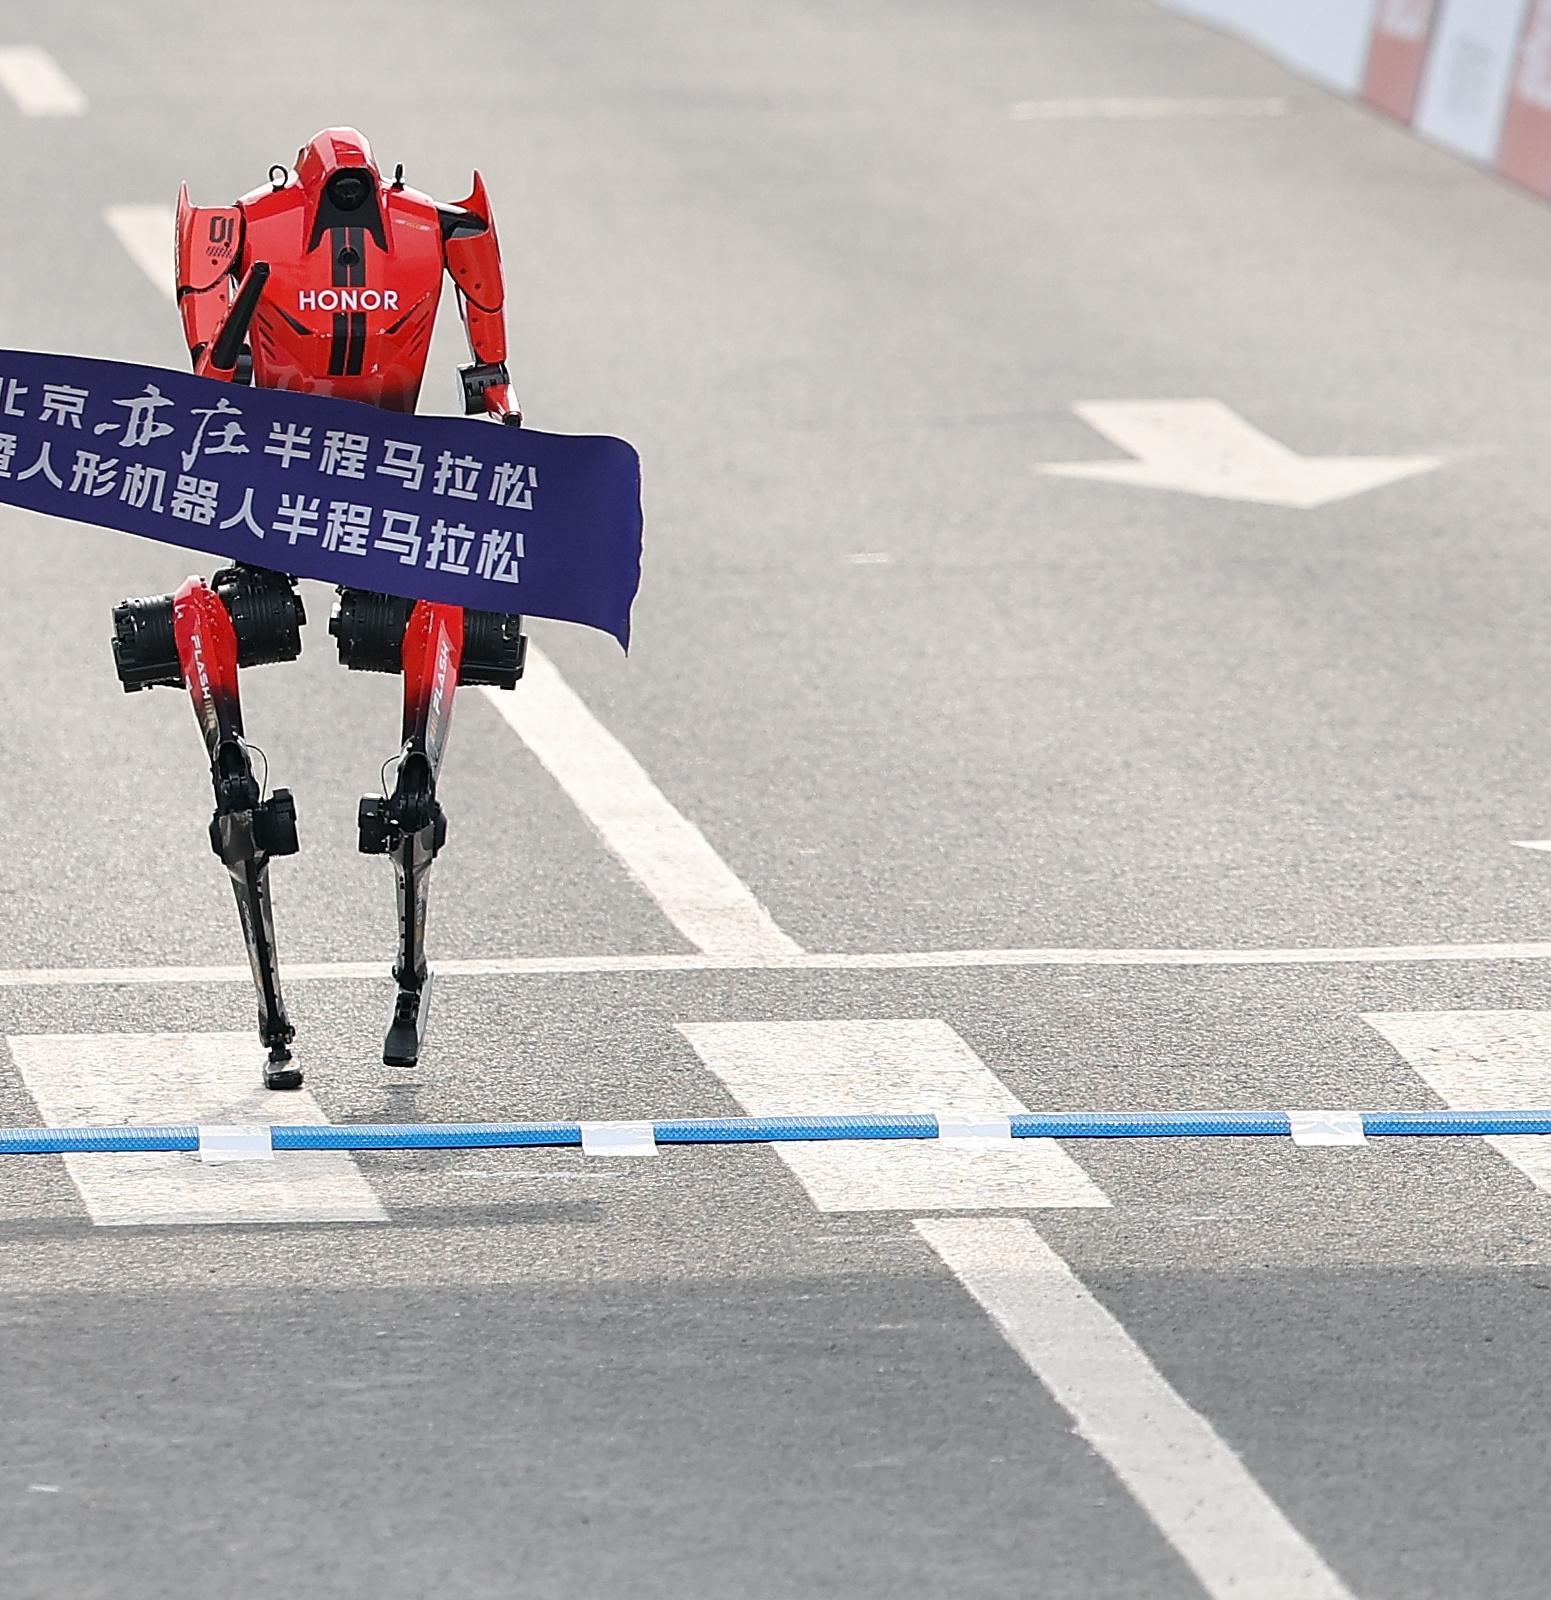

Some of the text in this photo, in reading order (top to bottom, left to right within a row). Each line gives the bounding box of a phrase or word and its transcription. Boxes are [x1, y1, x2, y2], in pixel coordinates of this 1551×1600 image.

[208, 215, 235, 245] 01
[297, 288, 400, 312] HONOR
[190, 634, 212, 700] FLASH
[432, 639, 451, 716] FLASH
